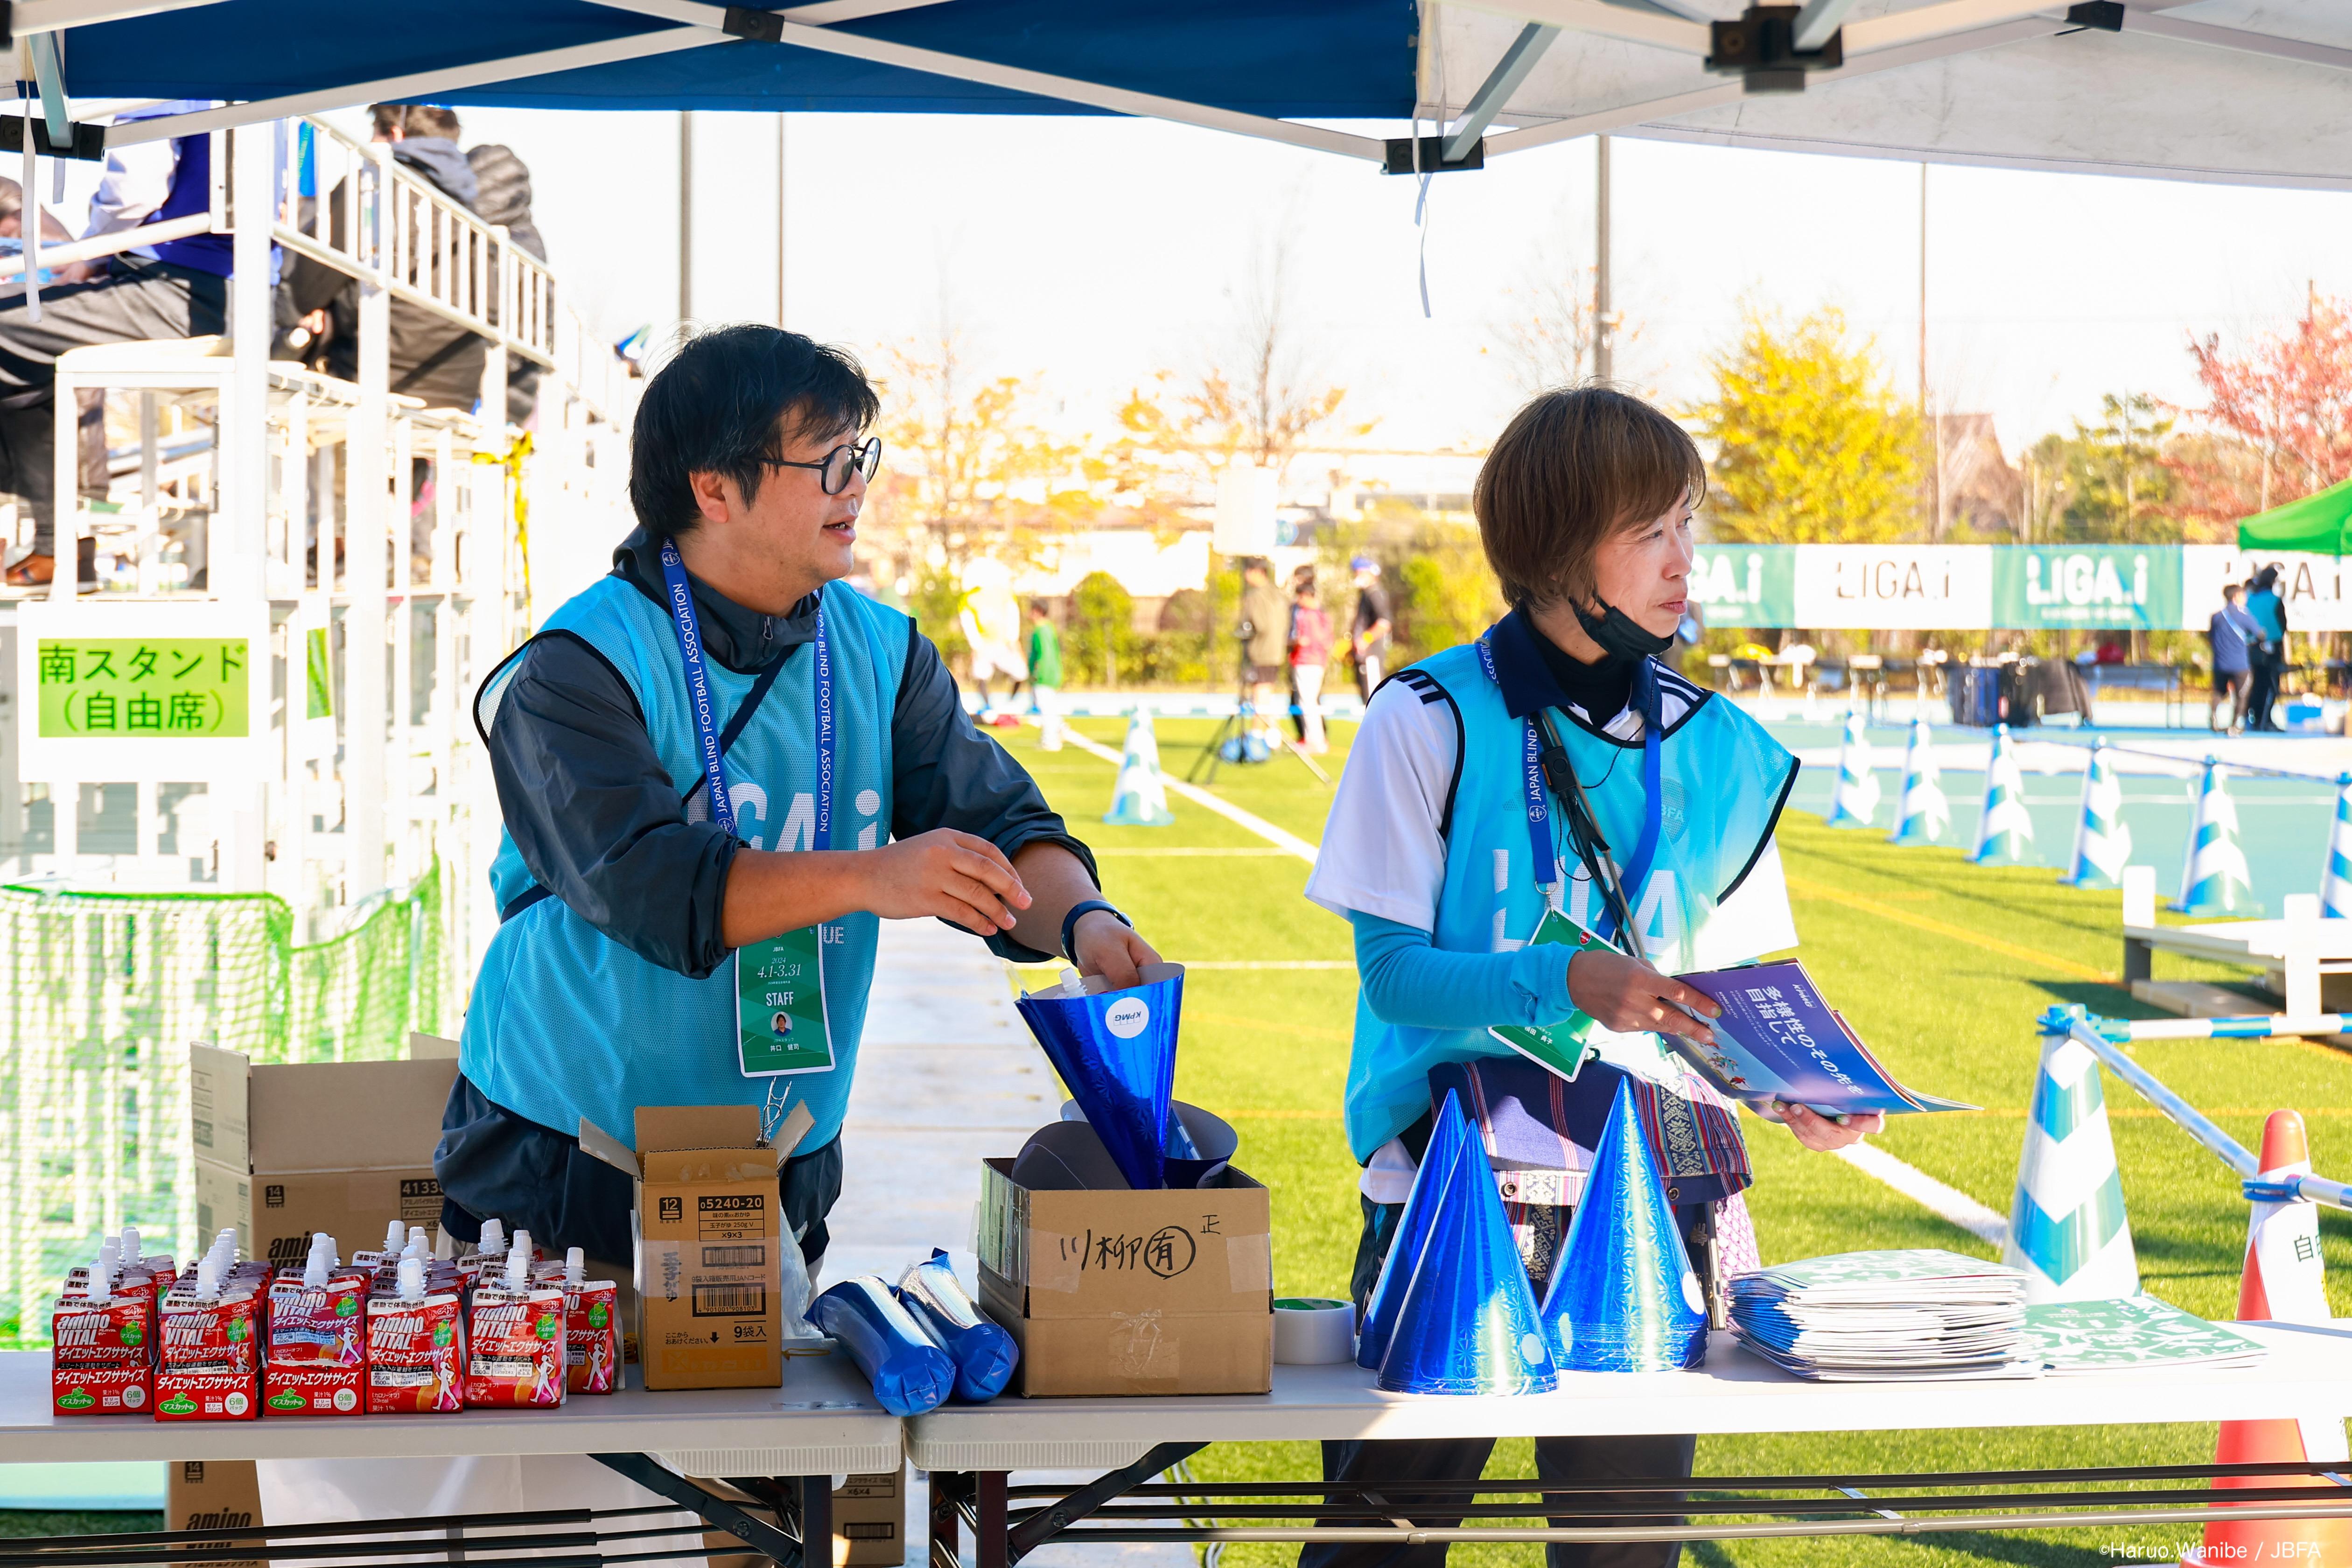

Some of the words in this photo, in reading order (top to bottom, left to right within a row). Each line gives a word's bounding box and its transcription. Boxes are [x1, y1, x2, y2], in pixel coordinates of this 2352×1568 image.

[672, 583, 700, 663] ASSOCIATION
[39, 644, 246, 684] 南スタンド
[818, 642, 828, 677] BLIND
[692, 667, 712, 732] FOOTBALL
[820, 681, 831, 744] FOOTBALL
[705, 736, 719, 773] BLIND
[1527, 729, 1537, 762] BLIND
[820, 748, 830, 832] ASSOCIATION
[1528, 766, 1541, 801] JAPAN
[712, 776, 728, 813] JAPAN
[757, 964, 801, 978] 4.1-3.31
[766, 991, 794, 1007] STAFF
[1792, 984, 1813, 1008] KPMG
[1114, 1011, 1141, 1022] KPMG
[1745, 988, 1798, 1045] 目指して
[1762, 986, 1864, 1095] 多様性のその先を
[269, 1187, 280, 1197] 14
[403, 1181, 443, 1194] 4133
[663, 1199, 678, 1210] 12
[700, 1197, 762, 1209] 05240-20
[1200, 1214, 1220, 1235] 正
[692, 1274, 765, 1282] 9袋入箱販売用JANコード
[273, 1303, 313, 1318] VITAL
[474, 1304, 528, 1322] amino
[56, 1310, 110, 1330] amino
[165, 1311, 219, 1329] amino
[273, 1315, 360, 1329] ダイエットエクササイズ
[372, 1312, 424, 1334] amino
[57, 1329, 98, 1346] VITAL
[165, 1328, 204, 1346] VITAL
[472, 1320, 513, 1339] VITAL
[734, 1326, 767, 1338] 9袋入
[371, 1331, 411, 1350] VITAL
[471, 1339, 558, 1353] ダイエットエクササイズ
[58, 1346, 145, 1359] ダイエットエクササイズ
[165, 1342, 251, 1359] ダイエットエクササイズ
[370, 1346, 455, 1364] ダイエットエクササイズ
[55, 1369, 147, 1385] ダイエットエクササイズ
[157, 1376, 251, 1390] ダイエットエクササイズ
[267, 1372, 360, 1386] ダイエットエクササイズ
[188, 1463, 200, 1472] 14
[186, 1507, 252, 1530] amino
